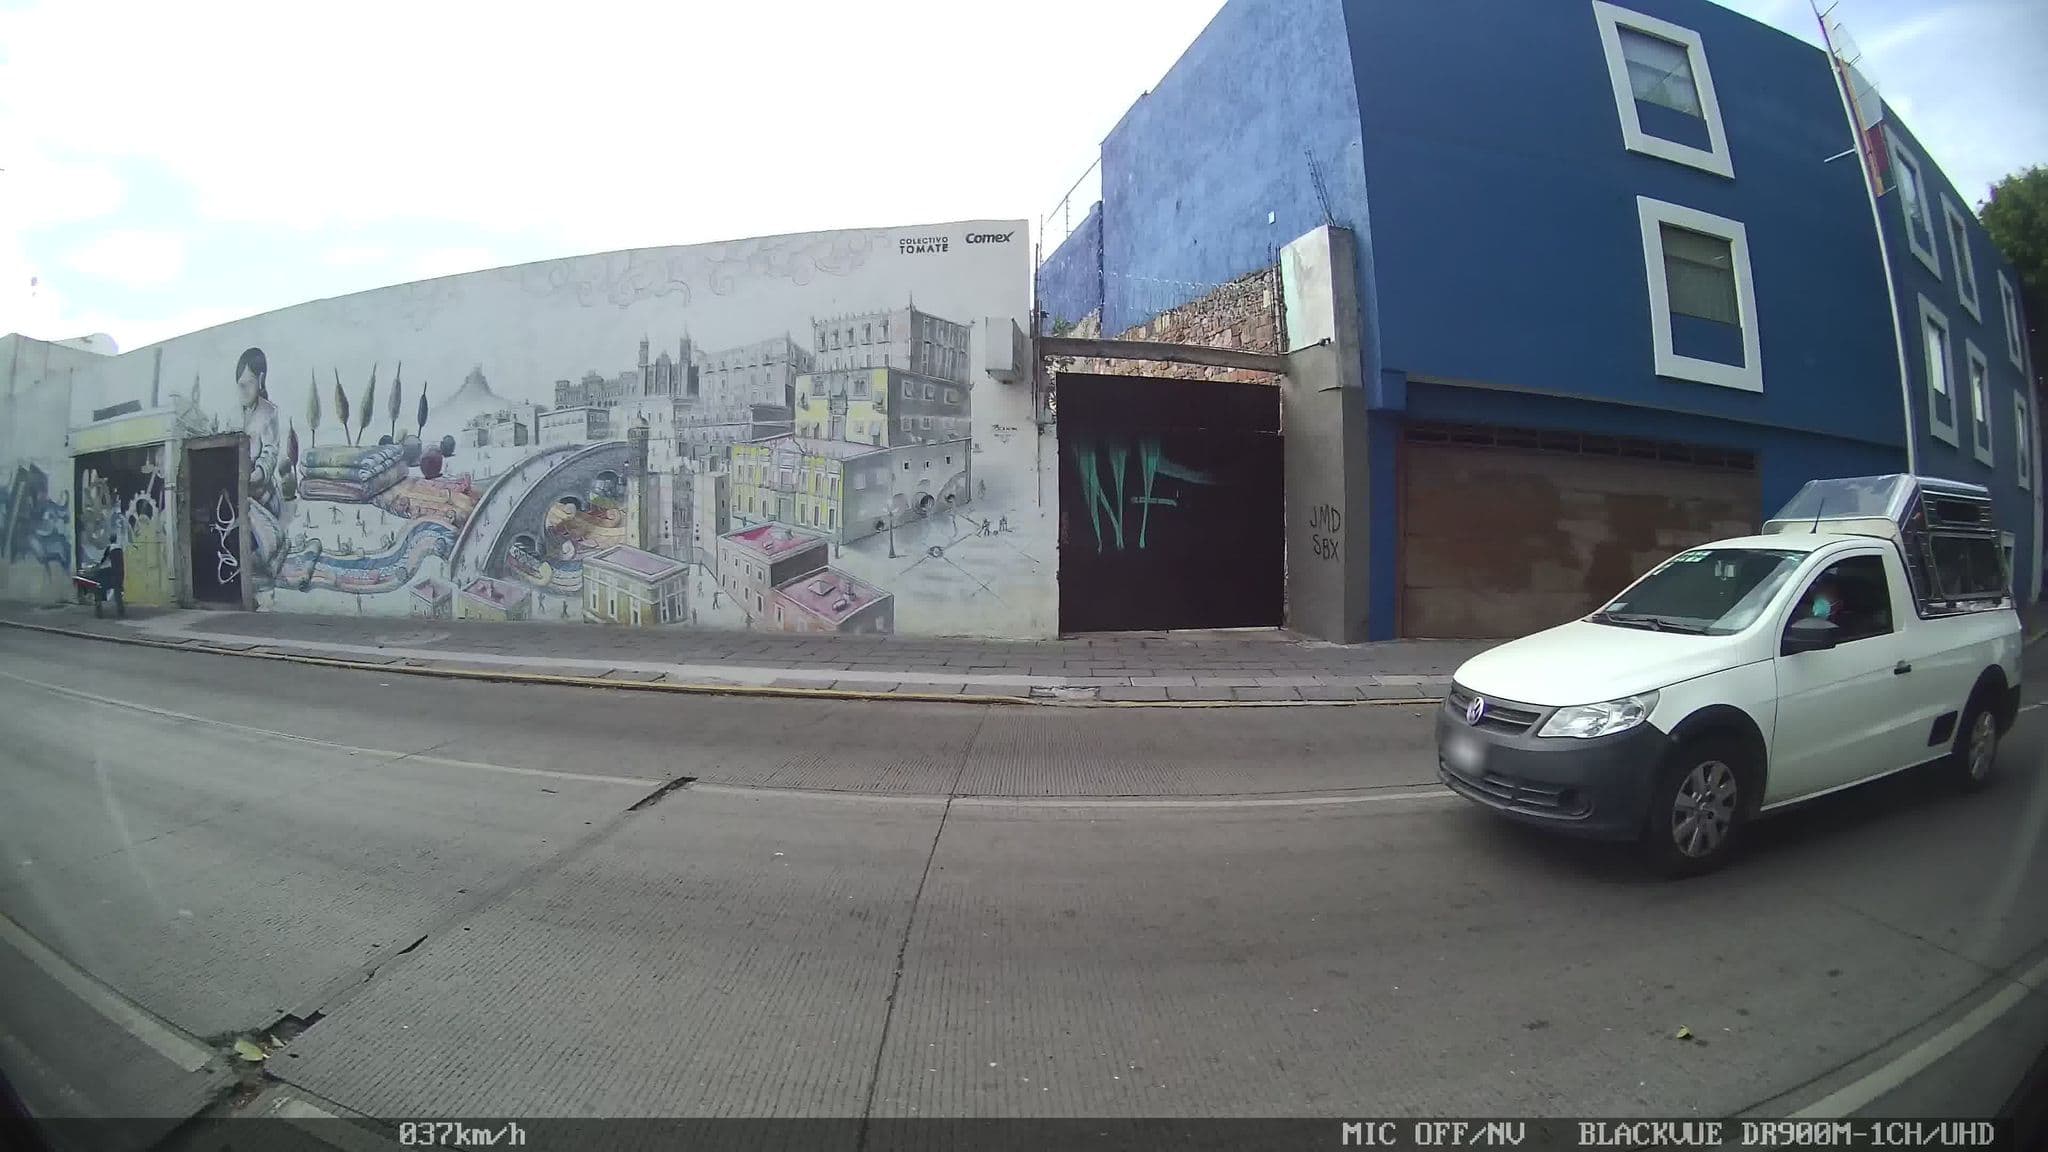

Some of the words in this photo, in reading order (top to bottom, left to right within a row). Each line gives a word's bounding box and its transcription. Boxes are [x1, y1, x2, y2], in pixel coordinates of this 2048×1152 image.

[900, 236, 949, 245] COLECTIVO
[965, 231, 1015, 244] Comex
[900, 243, 949, 255] TOMATE
[1310, 504, 1341, 533] JMD
